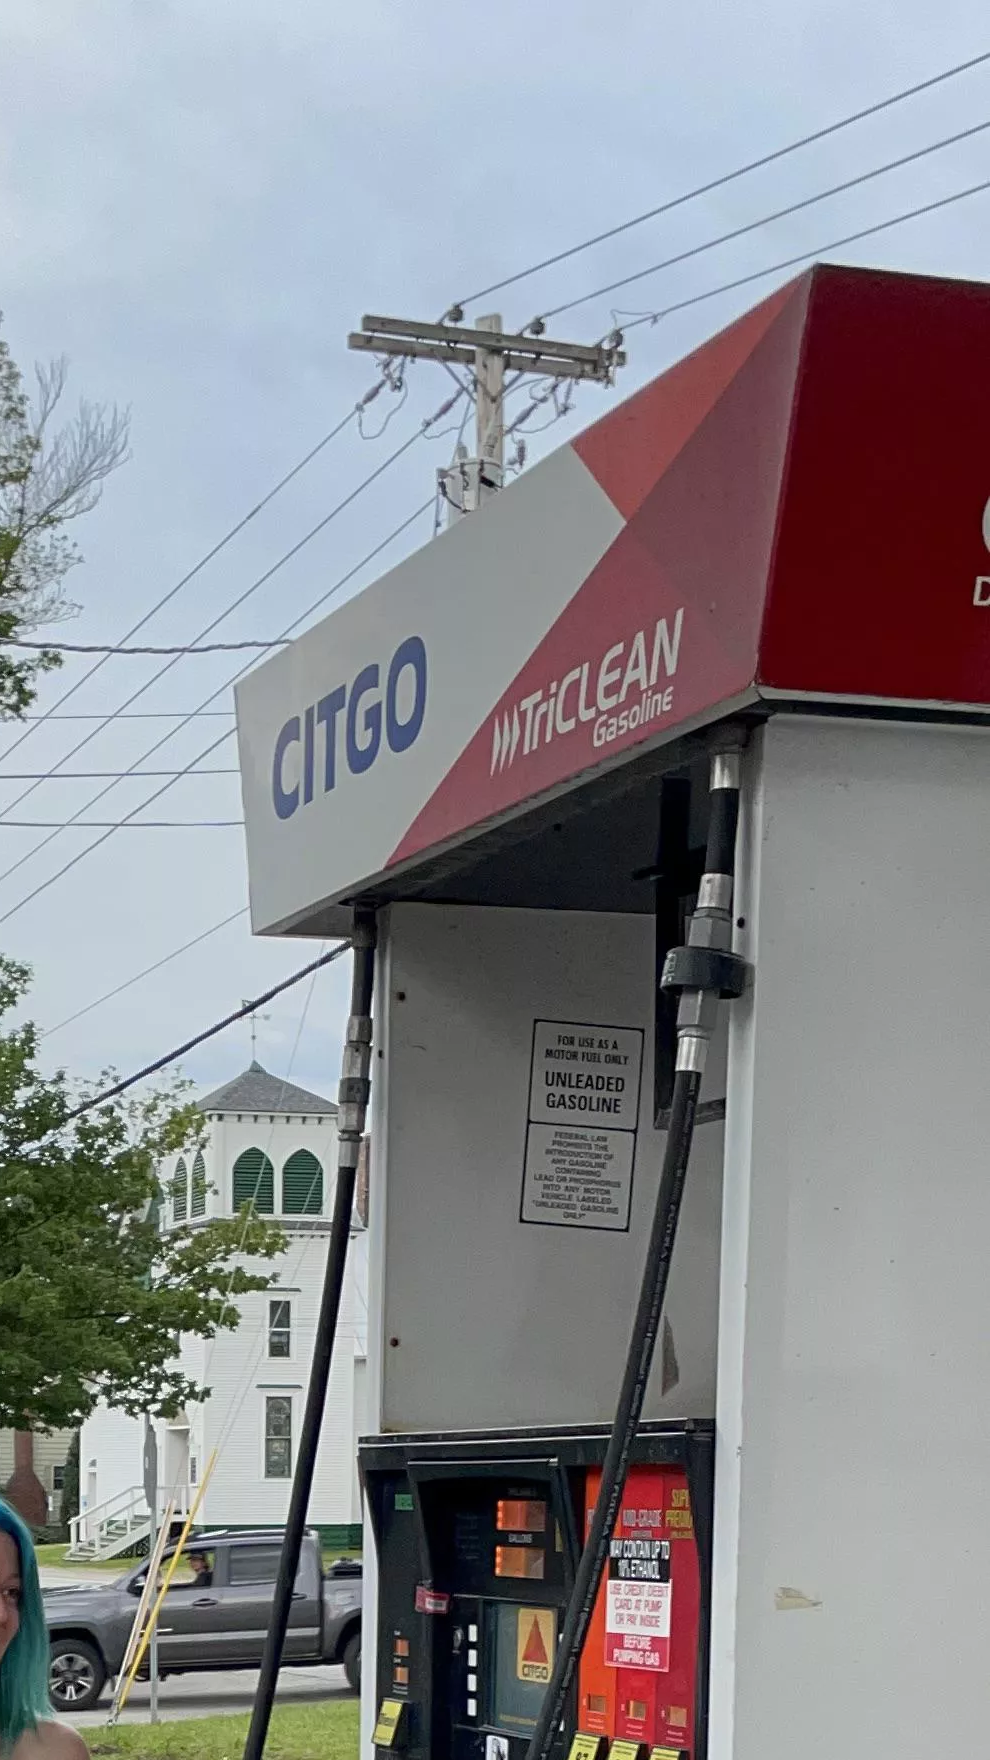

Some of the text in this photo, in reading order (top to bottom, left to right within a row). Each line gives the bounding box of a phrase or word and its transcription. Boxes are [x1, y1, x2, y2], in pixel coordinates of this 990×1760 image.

[521, 608, 684, 757] TriCLEAN
[272, 636, 427, 820] CITGO
[593, 685, 673, 749] Gasoline
[558, 1034, 618, 1050] FOR USE AS A
[545, 1048, 629, 1065] MOTOR FUEL ONLY
[545, 1070, 625, 1092] UNLEADED
[546, 1092, 621, 1113] GASOLINE
